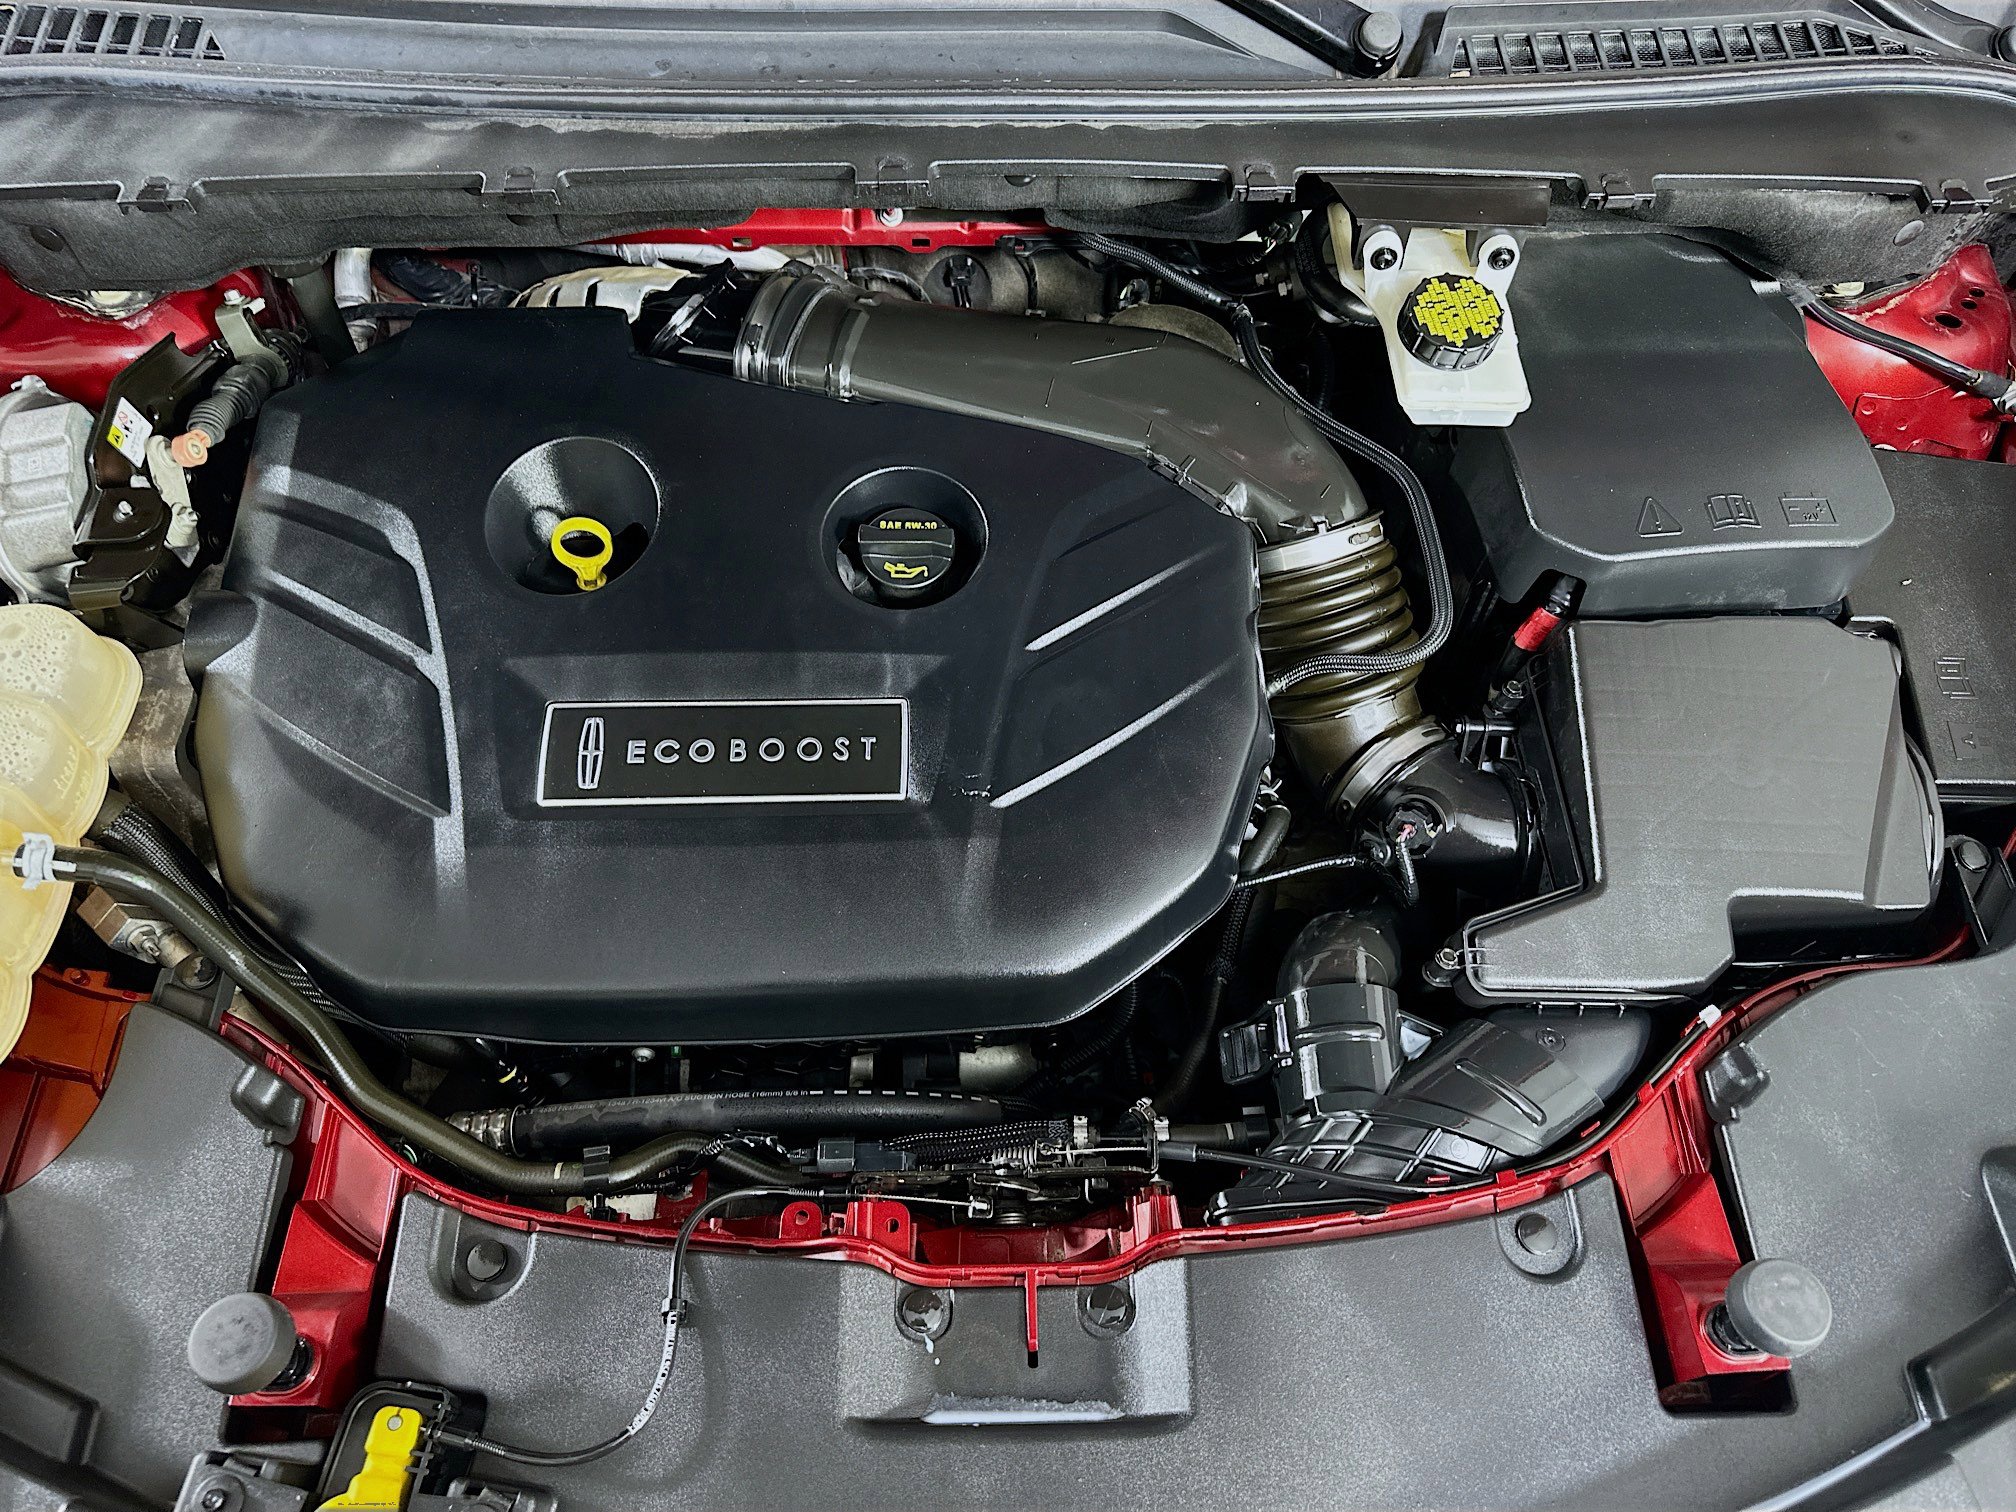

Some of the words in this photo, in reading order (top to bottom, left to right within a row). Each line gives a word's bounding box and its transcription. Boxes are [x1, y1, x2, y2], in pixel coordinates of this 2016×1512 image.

[879, 520, 902, 530] SAE
[626, 736, 877, 764] ECOBOOST
[684, 1092, 723, 1101] SUCTION
[724, 1091, 750, 1099] HOSE
[752, 1089, 783, 1098] (16mm)
